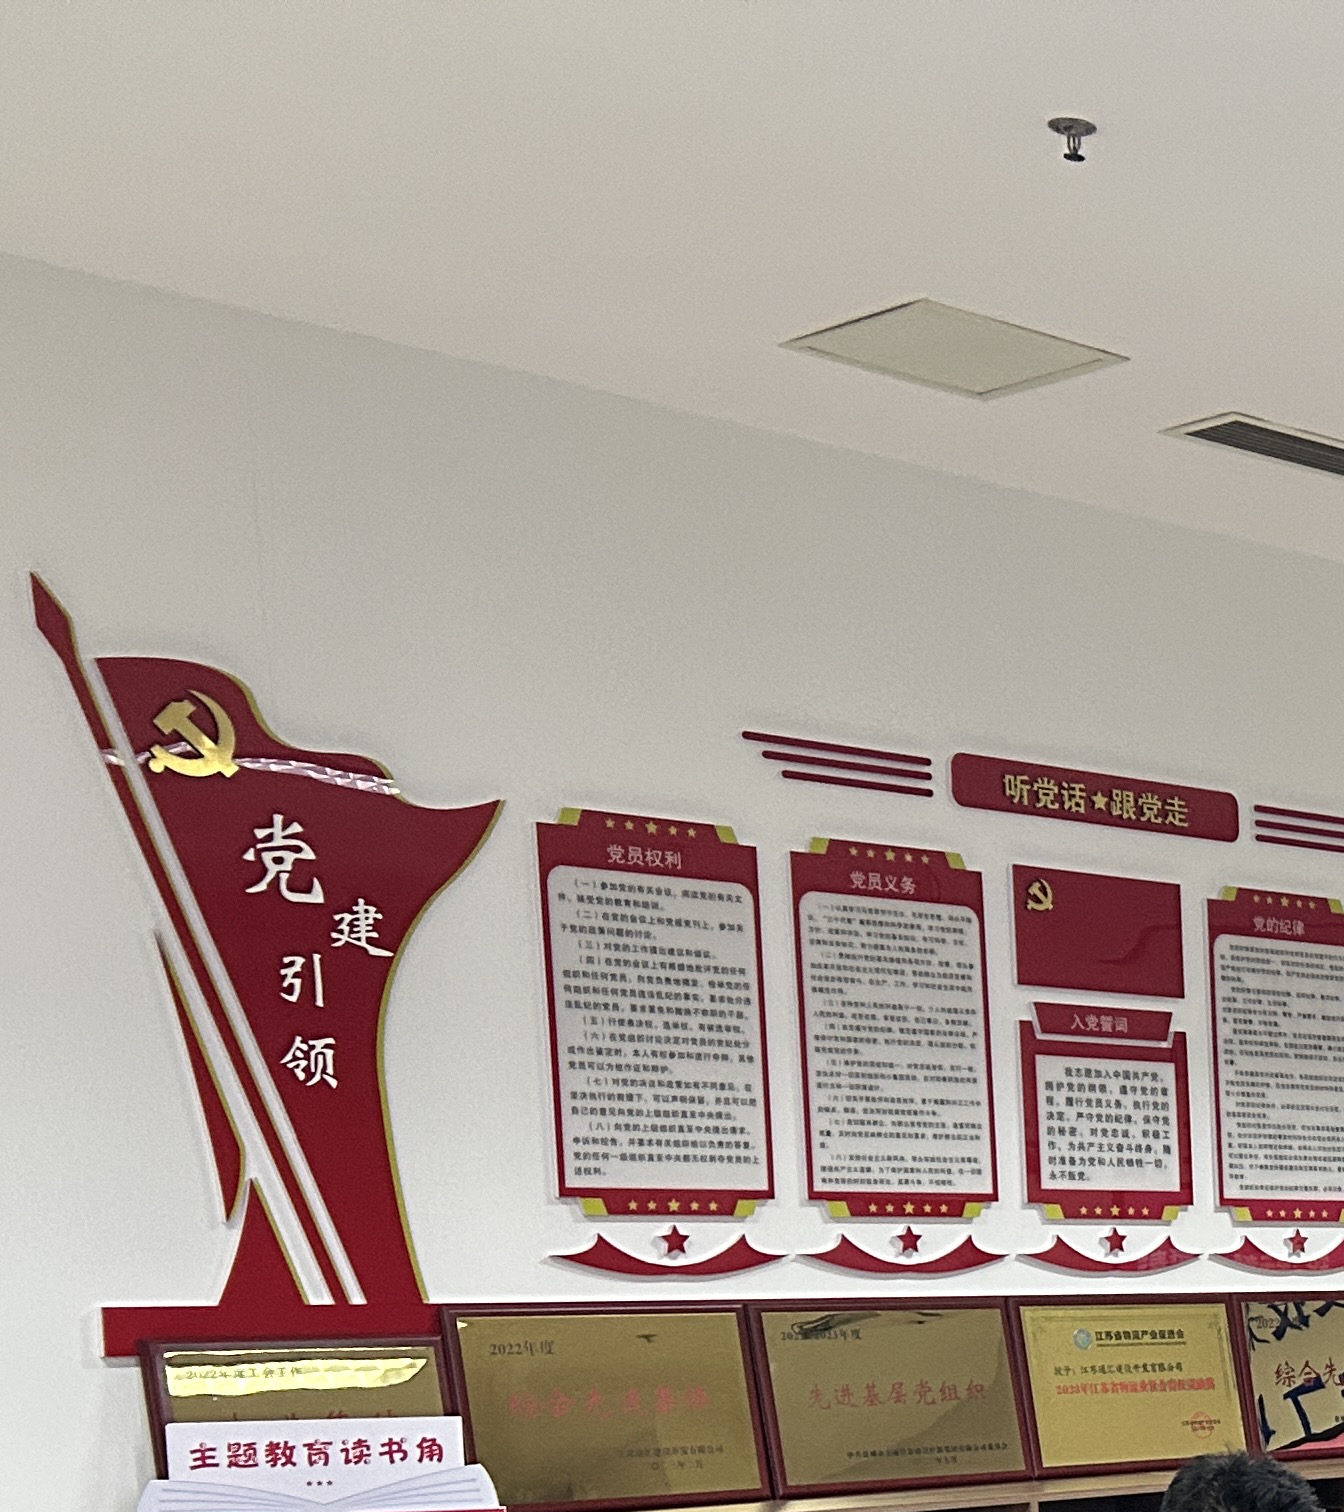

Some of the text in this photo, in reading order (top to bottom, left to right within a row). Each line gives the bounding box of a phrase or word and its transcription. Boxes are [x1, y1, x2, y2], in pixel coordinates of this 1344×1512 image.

[1001, 773, 1190, 829] 听党话 跟党走
[606, 844, 682, 870] 党员权利
[850, 870, 917, 895] 党员义务
[1252, 915, 1306, 936] 党的纪律
[242, 812, 395, 1089] 党建引领
[1069, 1012, 1129, 1034] 入党誓词
[808, 1379, 988, 1410] 先进基层党组织
[189, 1435, 446, 1471] 主题教育读书角
